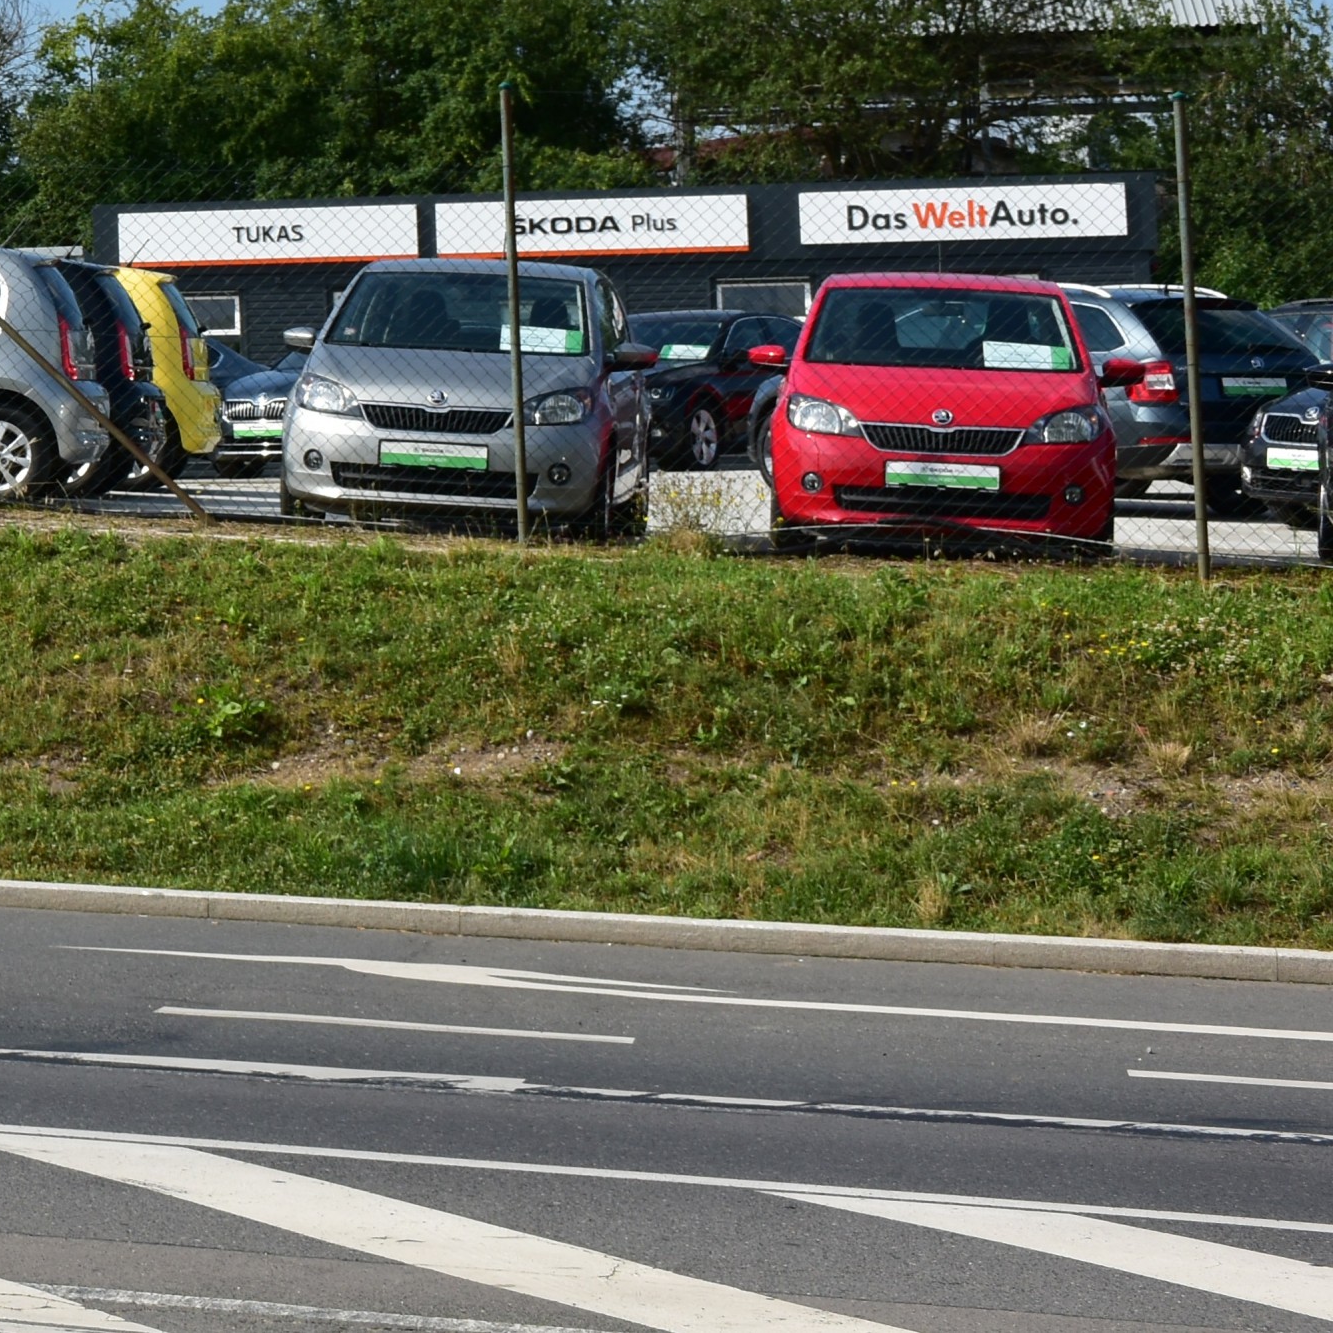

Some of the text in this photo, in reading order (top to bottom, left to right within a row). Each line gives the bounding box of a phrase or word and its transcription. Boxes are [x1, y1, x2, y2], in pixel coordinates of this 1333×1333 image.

[631, 213, 678, 232] Plus
[846, 199, 1079, 231] Das WeltAuto.
[233, 224, 304, 243] TUKAS
